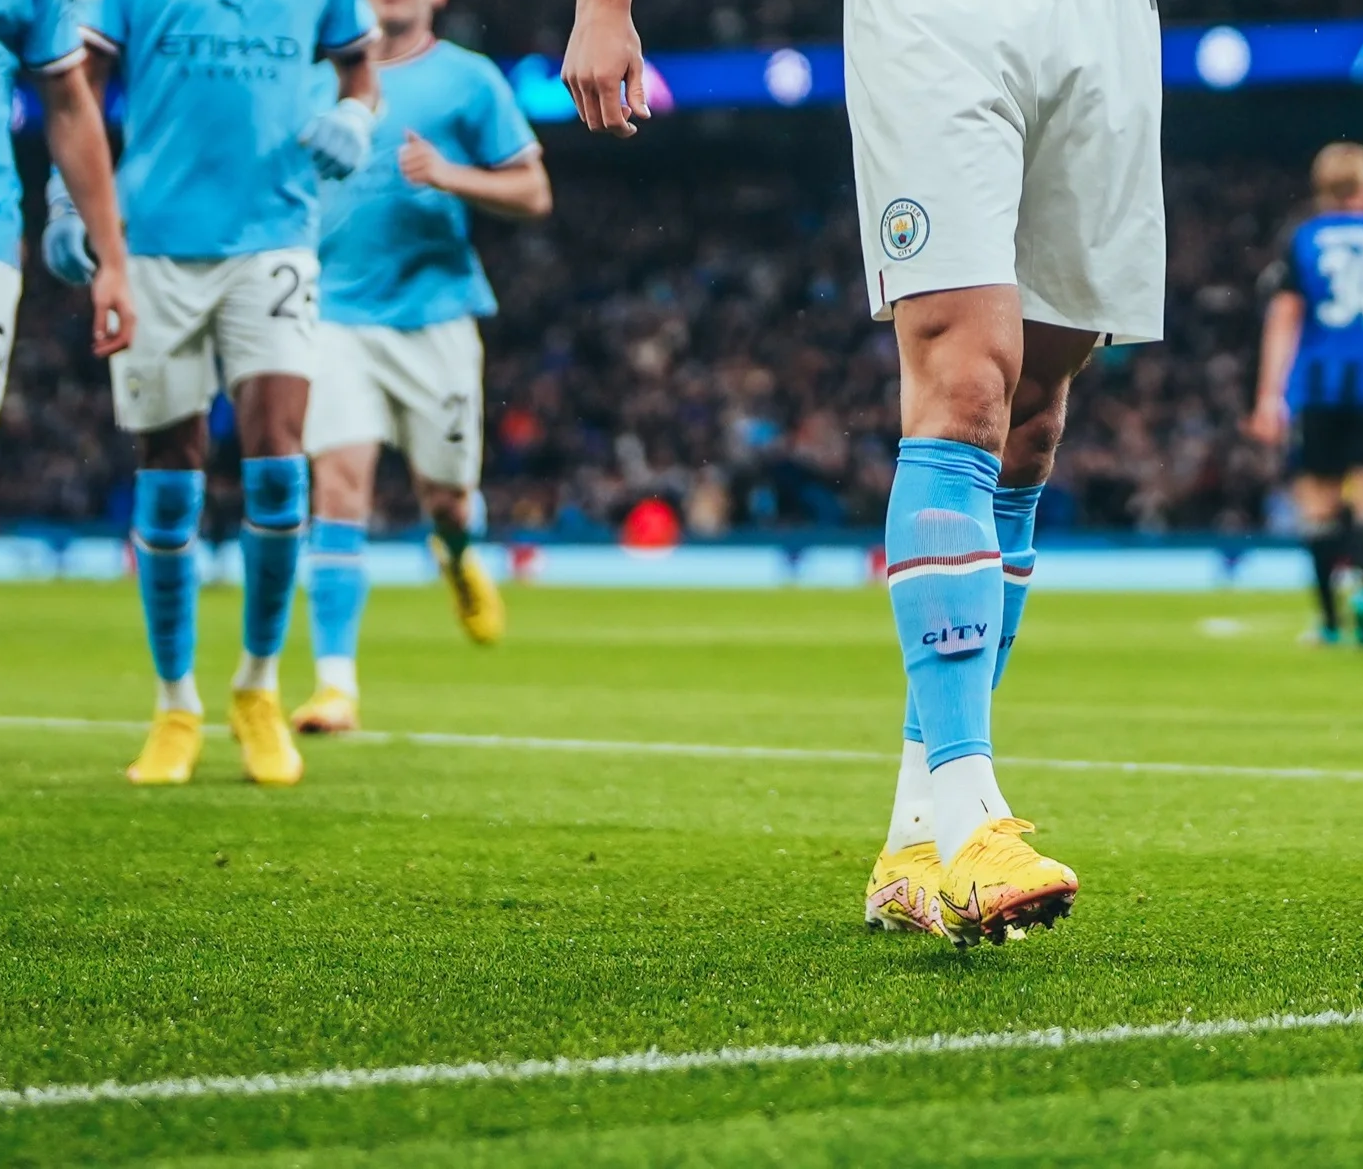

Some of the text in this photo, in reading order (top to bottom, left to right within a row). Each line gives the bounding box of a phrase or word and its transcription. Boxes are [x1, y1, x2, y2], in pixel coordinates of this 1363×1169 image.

[156, 33, 301, 59] ETIHAD
[884, 202, 922, 227] MANCHESTER
[898, 247, 913, 257] CITY
[922, 623, 988, 646] CITY
